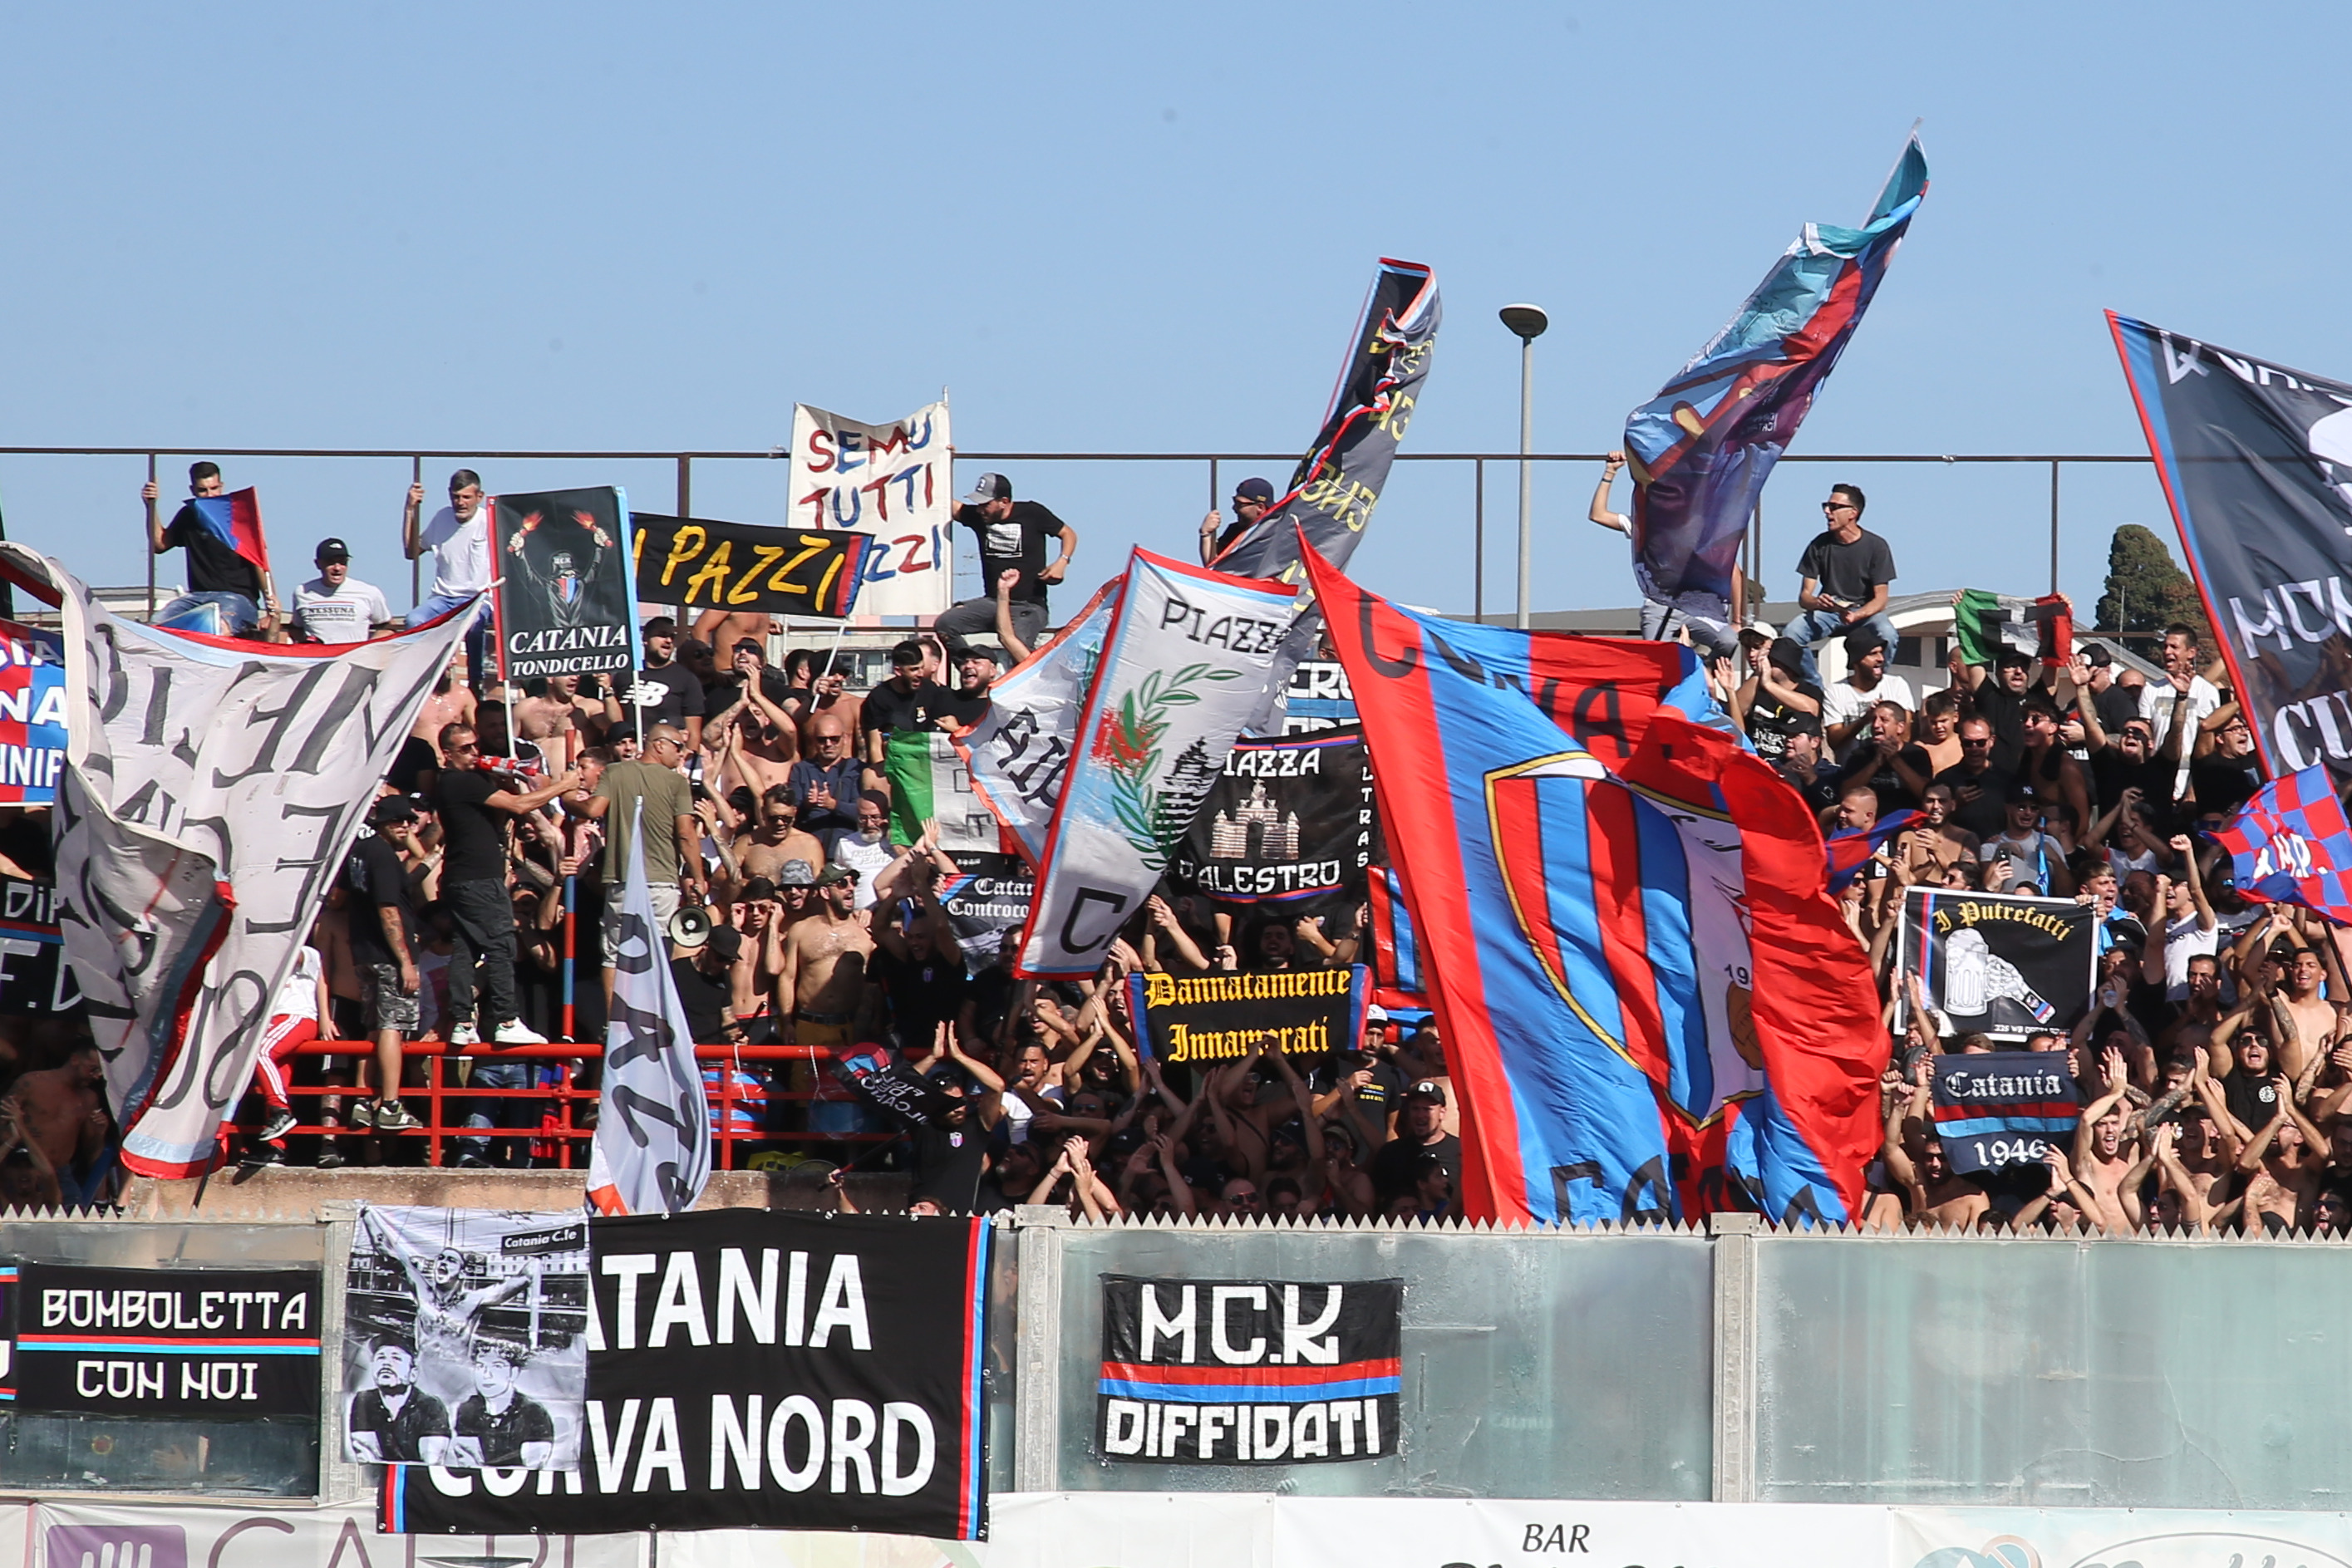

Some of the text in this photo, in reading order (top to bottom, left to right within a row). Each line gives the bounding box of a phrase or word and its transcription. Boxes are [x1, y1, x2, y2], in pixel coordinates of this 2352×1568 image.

[807, 412, 932, 474] SEMU
[798, 462, 934, 529] TUTTI
[661, 525, 844, 612] PAZZI
[863, 524, 940, 582] ZZI
[509, 625, 627, 654] CATANIA
[1159, 597, 1291, 653] PIAZZ
[512, 653, 629, 676] TONDICELLO
[1223, 748, 1321, 777] IAZZA
[1357, 745, 1375, 868] LTRAS
[1957, 902, 2074, 941] Putrefatti
[1144, 968, 1352, 1010] Dannatamente
[1725, 963, 1749, 985] 19
[1946, 1069, 2062, 1098] Catania
[1974, 1138, 2048, 1167] 1946
[504, 1229, 577, 1248] Catania C.le
[42, 1290, 307, 1330] BOMBOLETTA
[586, 1248, 872, 1351] TANIA
[76, 1360, 258, 1401] CON NOI
[709, 1394, 937, 1496] NORD
[1105, 1398, 1381, 1461] DIFFIDATI
[1522, 1524, 1591, 1553] BAR
